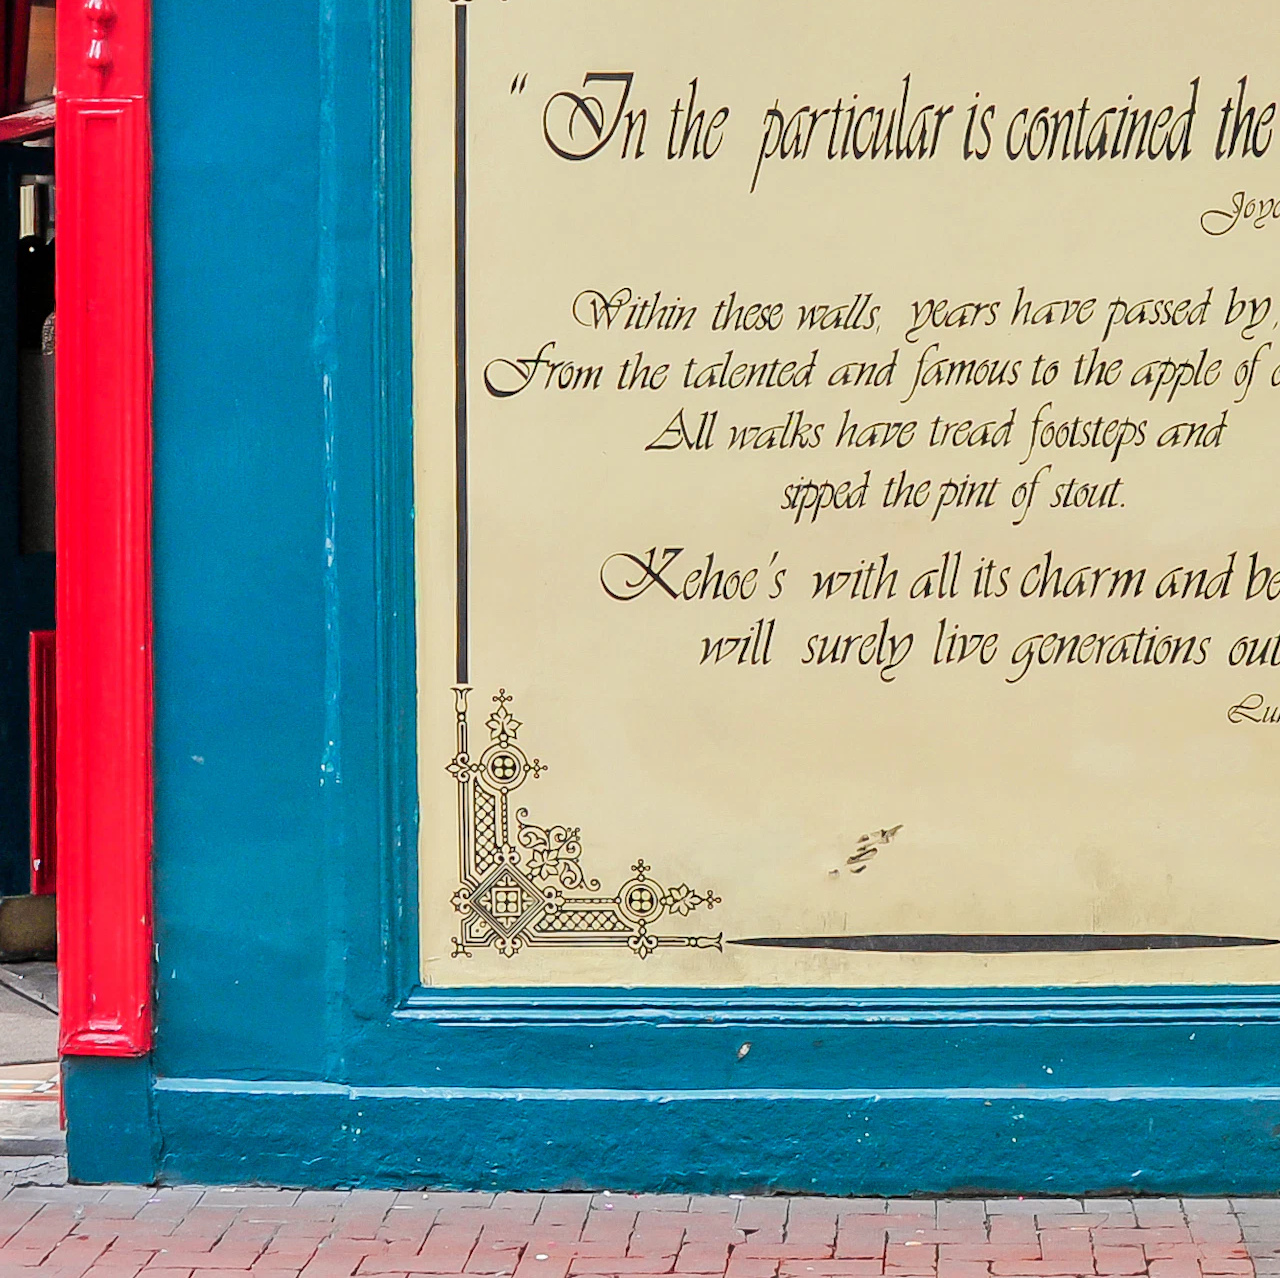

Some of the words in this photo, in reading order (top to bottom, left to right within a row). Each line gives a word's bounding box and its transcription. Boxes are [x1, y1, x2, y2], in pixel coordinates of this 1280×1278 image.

[667, 76, 730, 160] the
[749, 72, 955, 194] particular
[963, 91, 996, 161] is
[1006, 76, 1201, 162] contained
[1215, 74, 1277, 161] the
[572, 287, 697, 331] Within
[711, 291, 784, 332] these
[797, 292, 881, 333] walls,
[905, 298, 1001, 344] years
[1010, 286, 1097, 326] have
[1101, 286, 1214, 343] passed
[1224, 286, 1278, 341] by,
[483, 341, 604, 398] From
[617, 351, 670, 390] the
[683, 348, 819, 389] talented
[827, 348, 900, 387] and
[899, 342, 1023, 404] famous
[1031, 354, 1060, 386] to
[1073, 346, 1124, 386] the
[1130, 347, 1223, 403] apple
[1233, 341, 1273, 404] of
[644, 407, 718, 451] All
[727, 409, 825, 450] walks
[835, 408, 918, 449] have
[929, 407, 1017, 448] tread
[1018, 401, 1148, 466] footsteps
[1156, 409, 1229, 448] and
[780, 469, 872, 525] sipped
[882, 469, 931, 508] the
[931, 474, 999, 522] pint
[1011, 464, 1052, 526] of
[1049, 477, 1125, 508] stout.
[600, 546, 787, 601] Kehoe's
[811, 552, 899, 600] with
[909, 550, 962, 599] all
[973, 557, 1012, 598] its
[1020, 550, 1147, 598] charm
[1155, 550, 1238, 600] and
[699, 618, 776, 665] will
[801, 617, 914, 683] surely
[933, 617, 999, 665] live
[1005, 625, 1212, 684] generations
